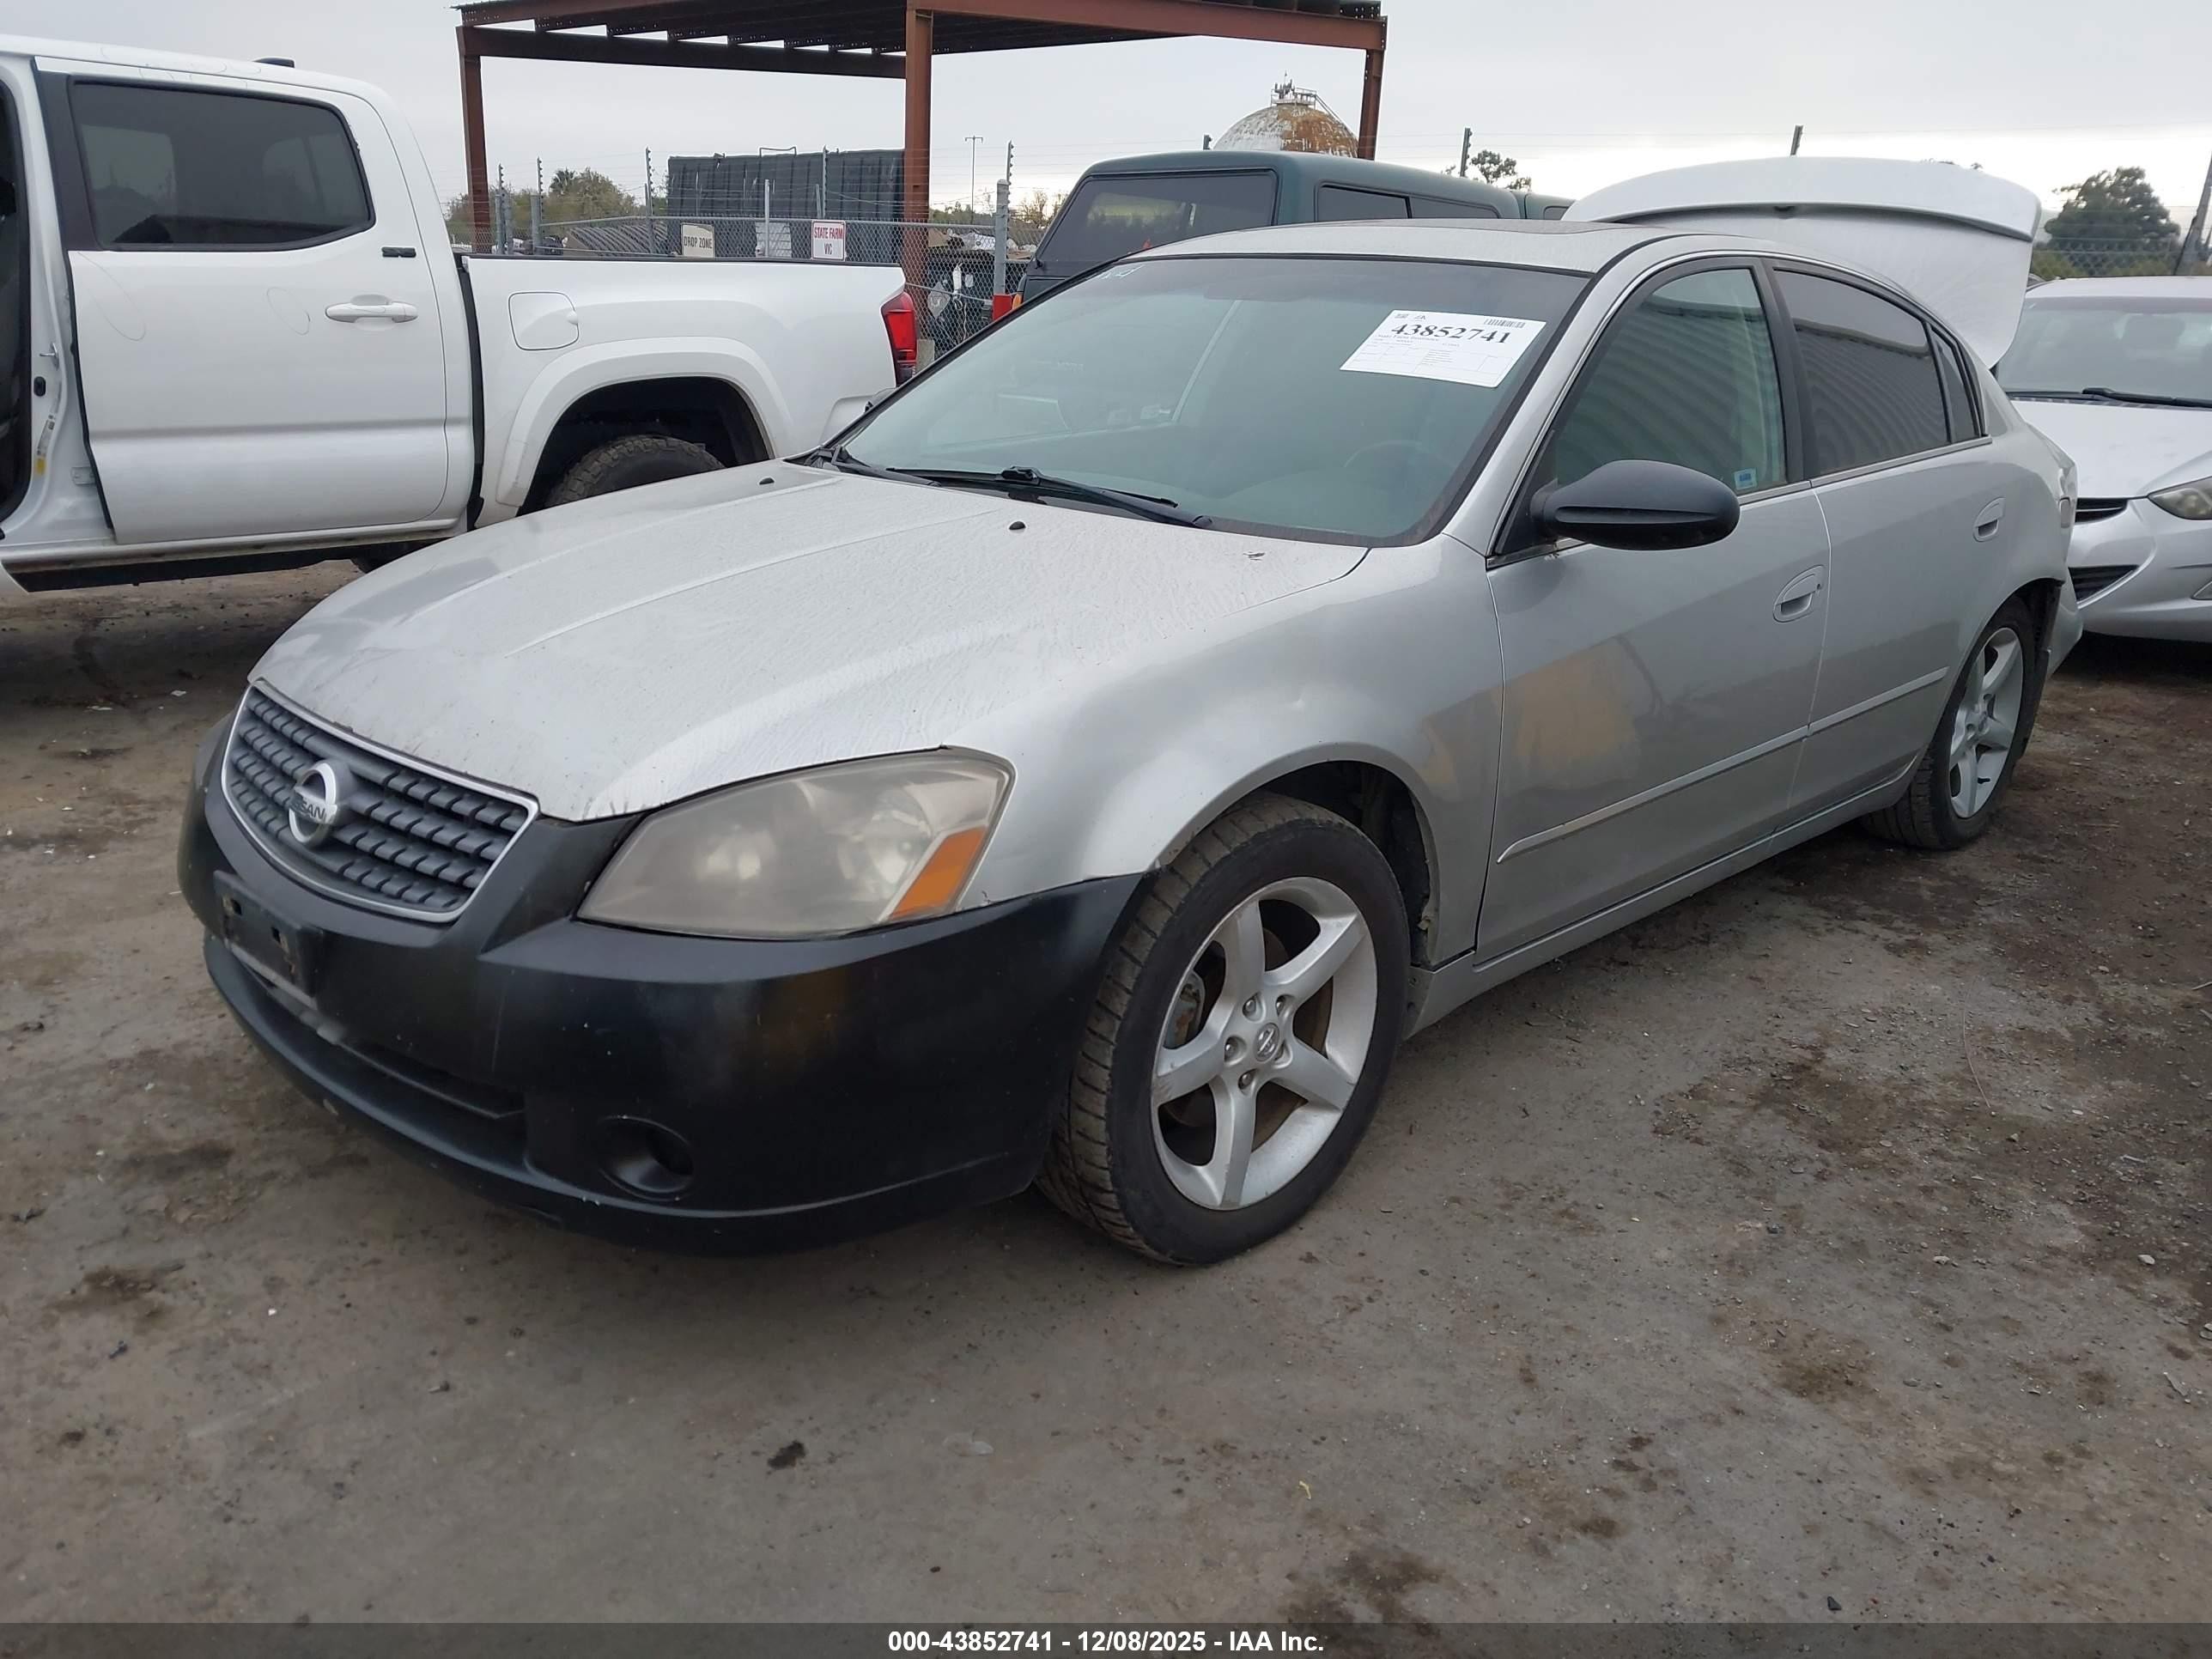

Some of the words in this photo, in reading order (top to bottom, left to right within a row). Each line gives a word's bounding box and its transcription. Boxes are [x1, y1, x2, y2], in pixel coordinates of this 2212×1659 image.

[814, 227, 828, 240] STATE
[829, 227, 843, 240] FARM
[684, 236, 697, 247] DROP
[699, 237, 713, 249] ZONE
[823, 243, 833, 255] VIC
[1391, 323, 1511, 343] 43852741
